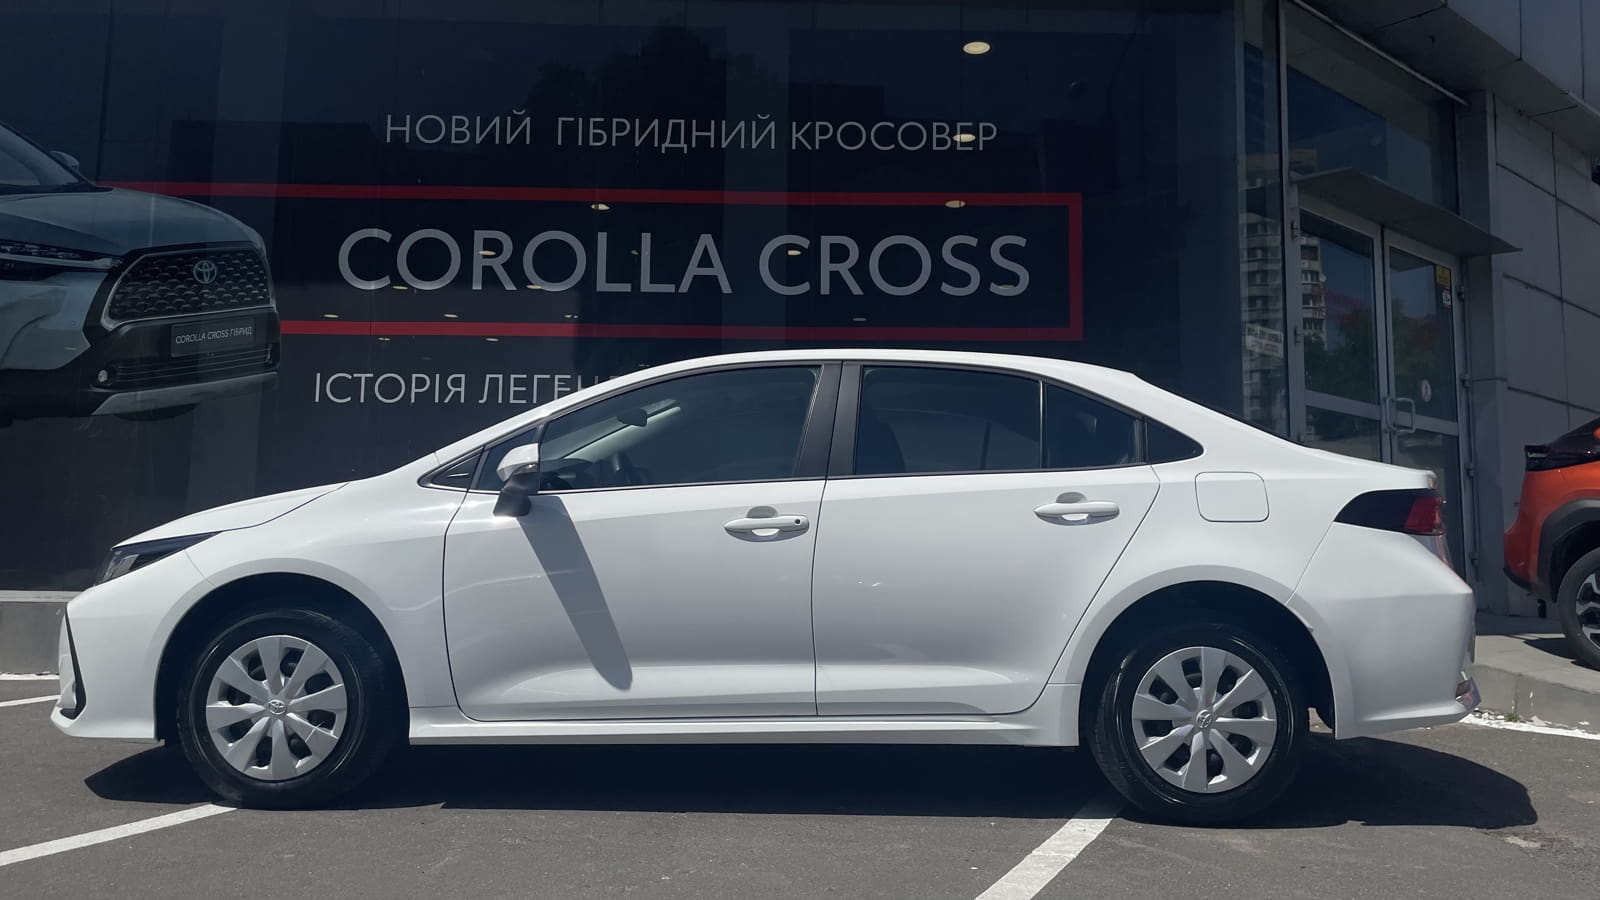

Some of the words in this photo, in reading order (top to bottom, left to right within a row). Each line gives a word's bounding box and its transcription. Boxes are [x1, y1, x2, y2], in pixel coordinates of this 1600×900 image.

[385, 109, 531, 145] НОВИЙ
[556, 113, 776, 154] ГІБРИДНИЙ
[791, 120, 998, 151] КРОСОВЕР
[337, 227, 733, 294] COROLLA
[757, 233, 1031, 297] CROSS
[175, 332, 206, 344] COROLLA
[207, 328, 229, 340] CROSS
[314, 372, 466, 404] ІСТОРІЯ
